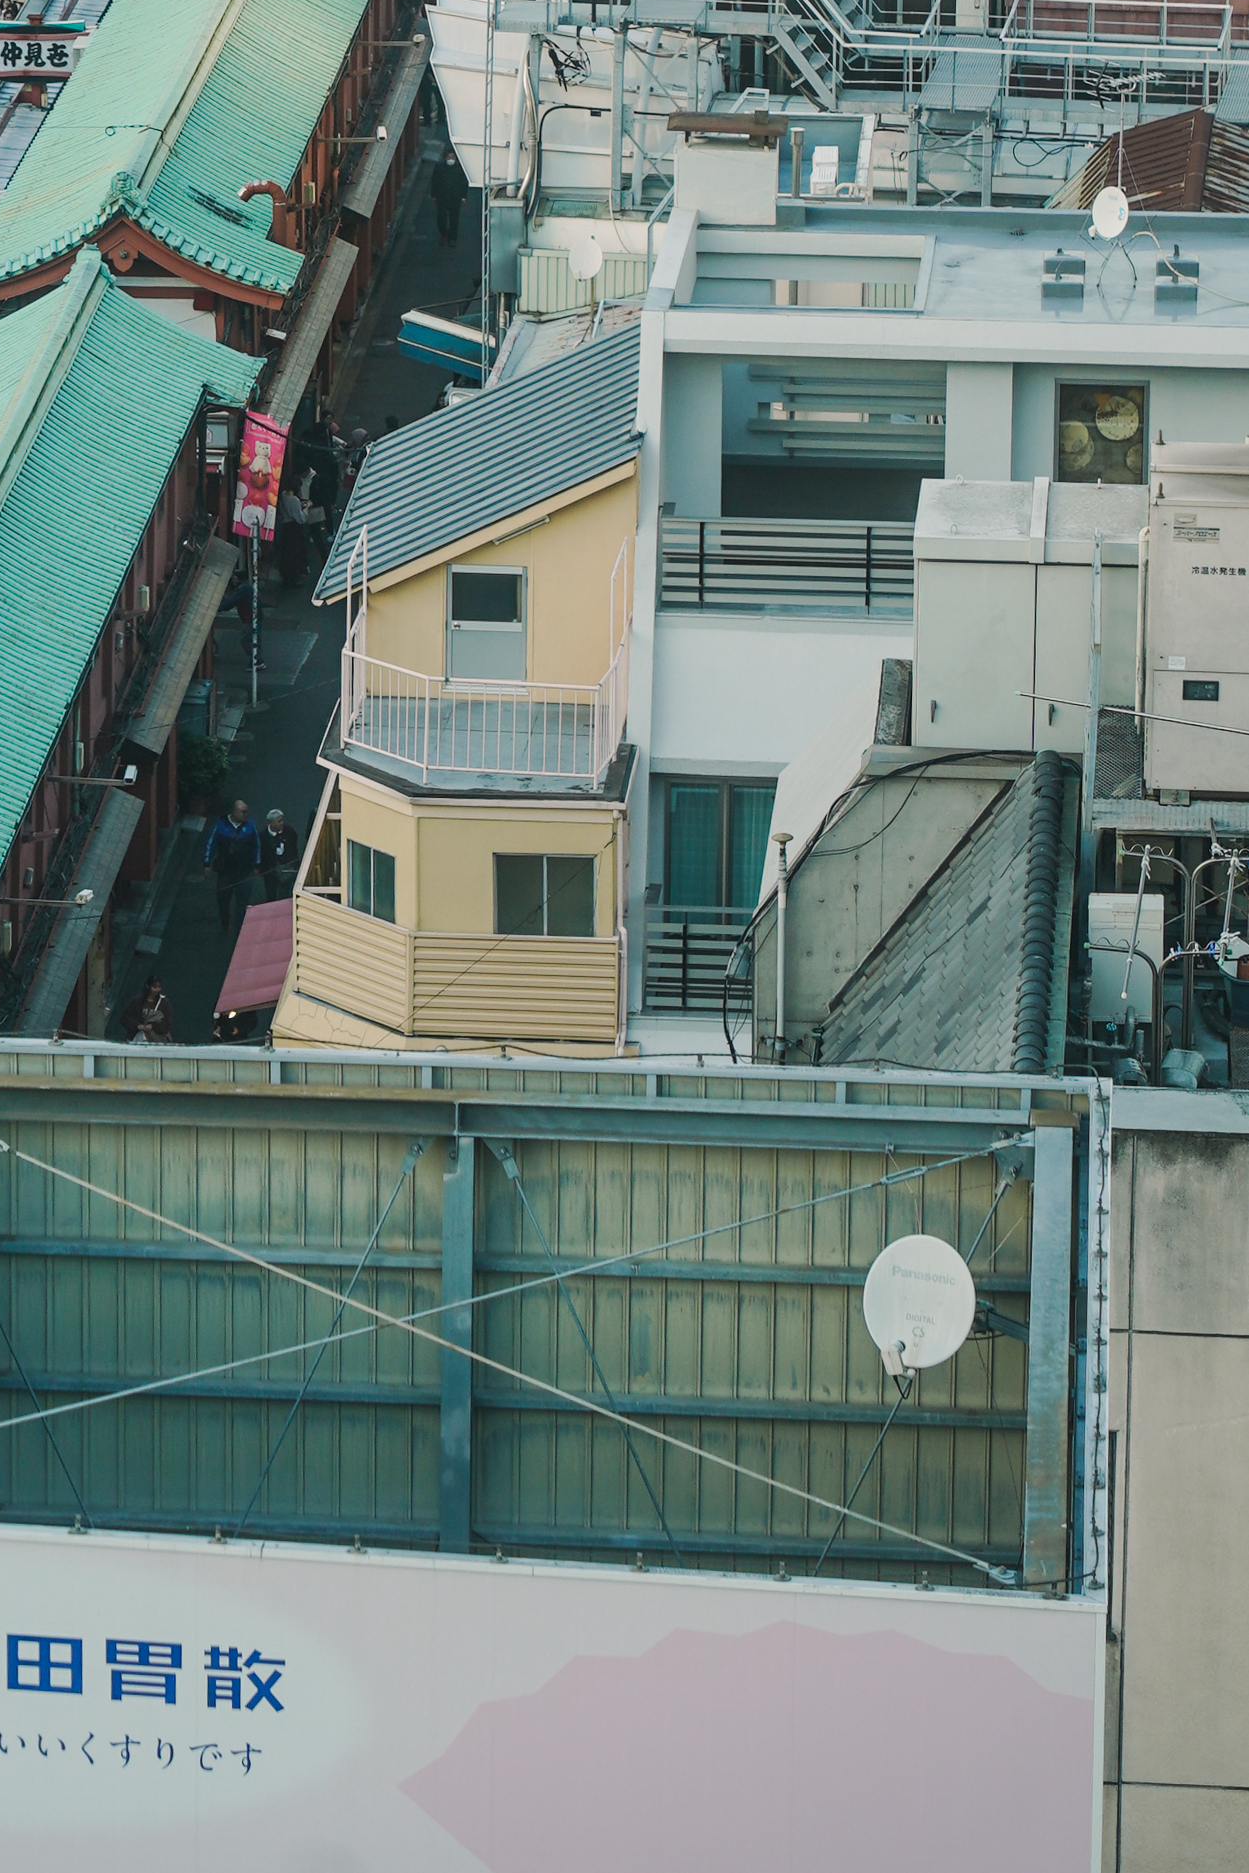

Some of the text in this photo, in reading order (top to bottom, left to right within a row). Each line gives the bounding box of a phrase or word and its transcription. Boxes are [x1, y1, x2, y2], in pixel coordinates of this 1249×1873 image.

[1191, 566, 1246, 576] 冷温水発生機
[891, 1264, 956, 1286] Panasonic
[906, 1313, 935, 1326] DIGITAL
[912, 1326, 925, 1338] CS
